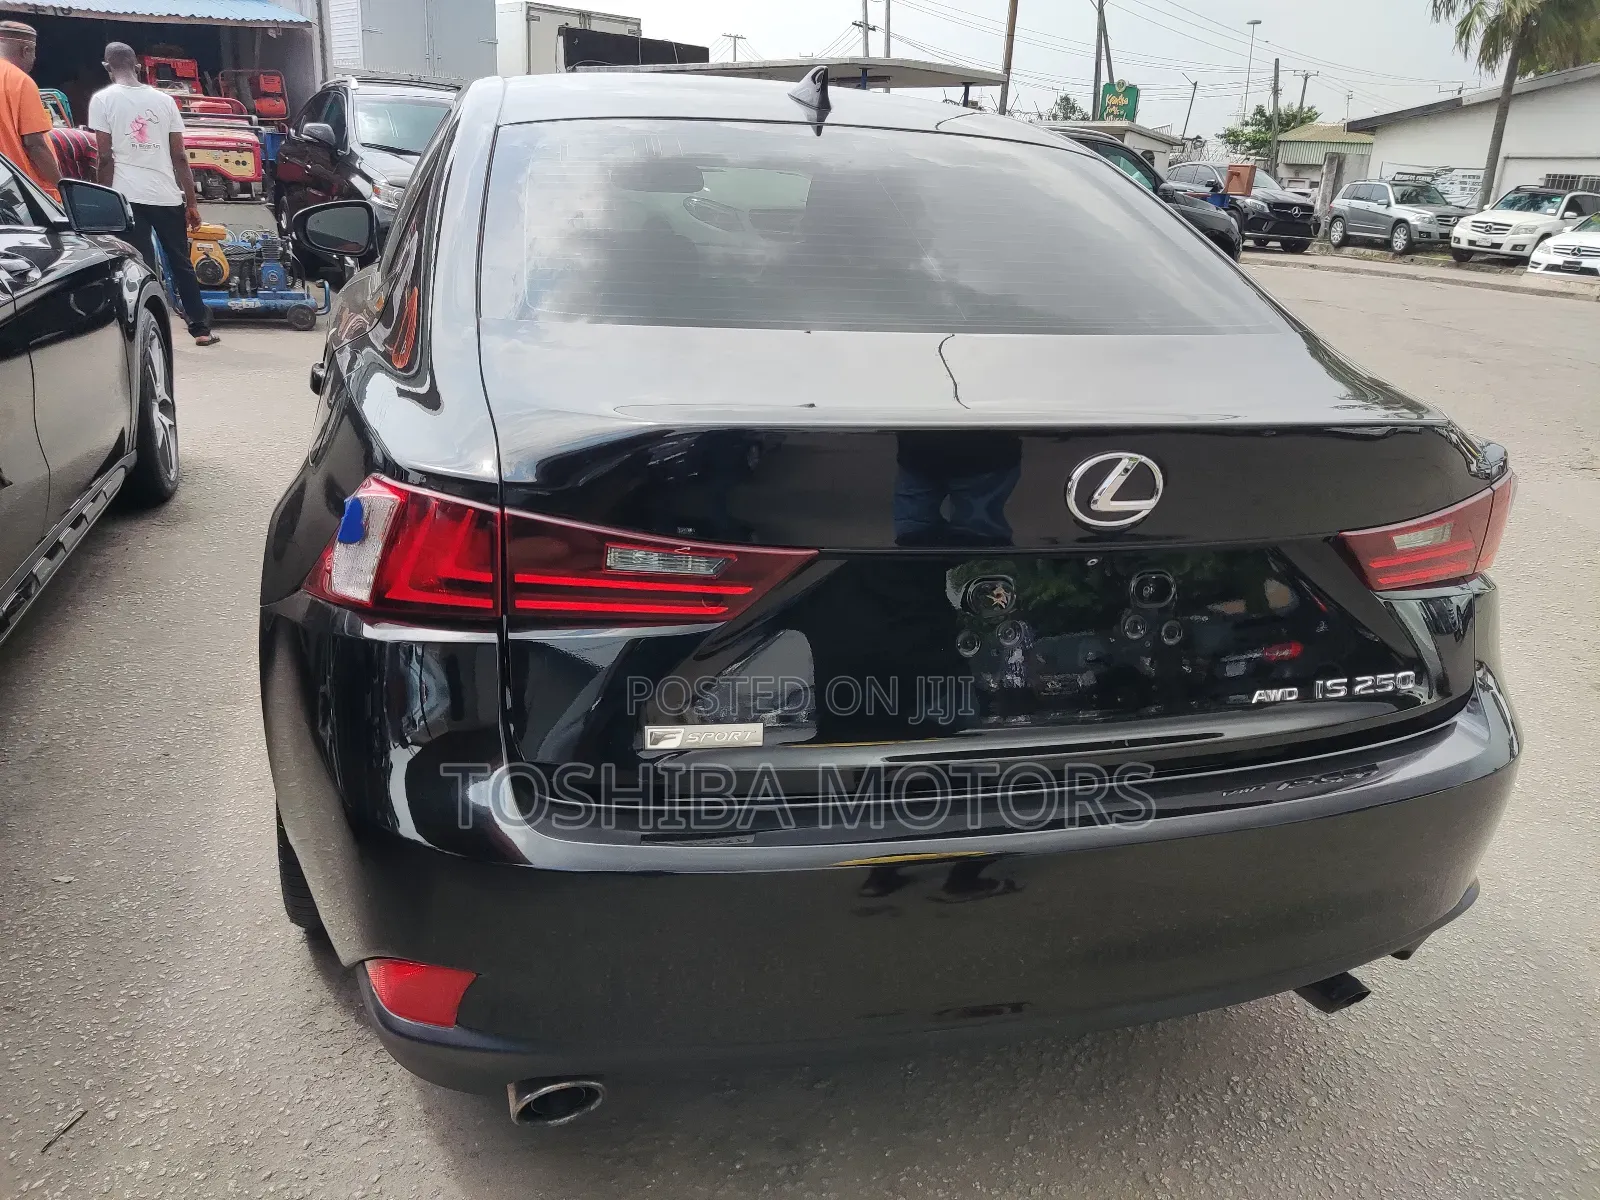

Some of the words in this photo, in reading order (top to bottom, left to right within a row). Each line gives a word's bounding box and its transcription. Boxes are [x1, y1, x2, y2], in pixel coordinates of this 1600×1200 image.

[1354, 671, 1416, 695] 250
[1252, 688, 1298, 703] AWD
[686, 731, 757, 743] SPORT
